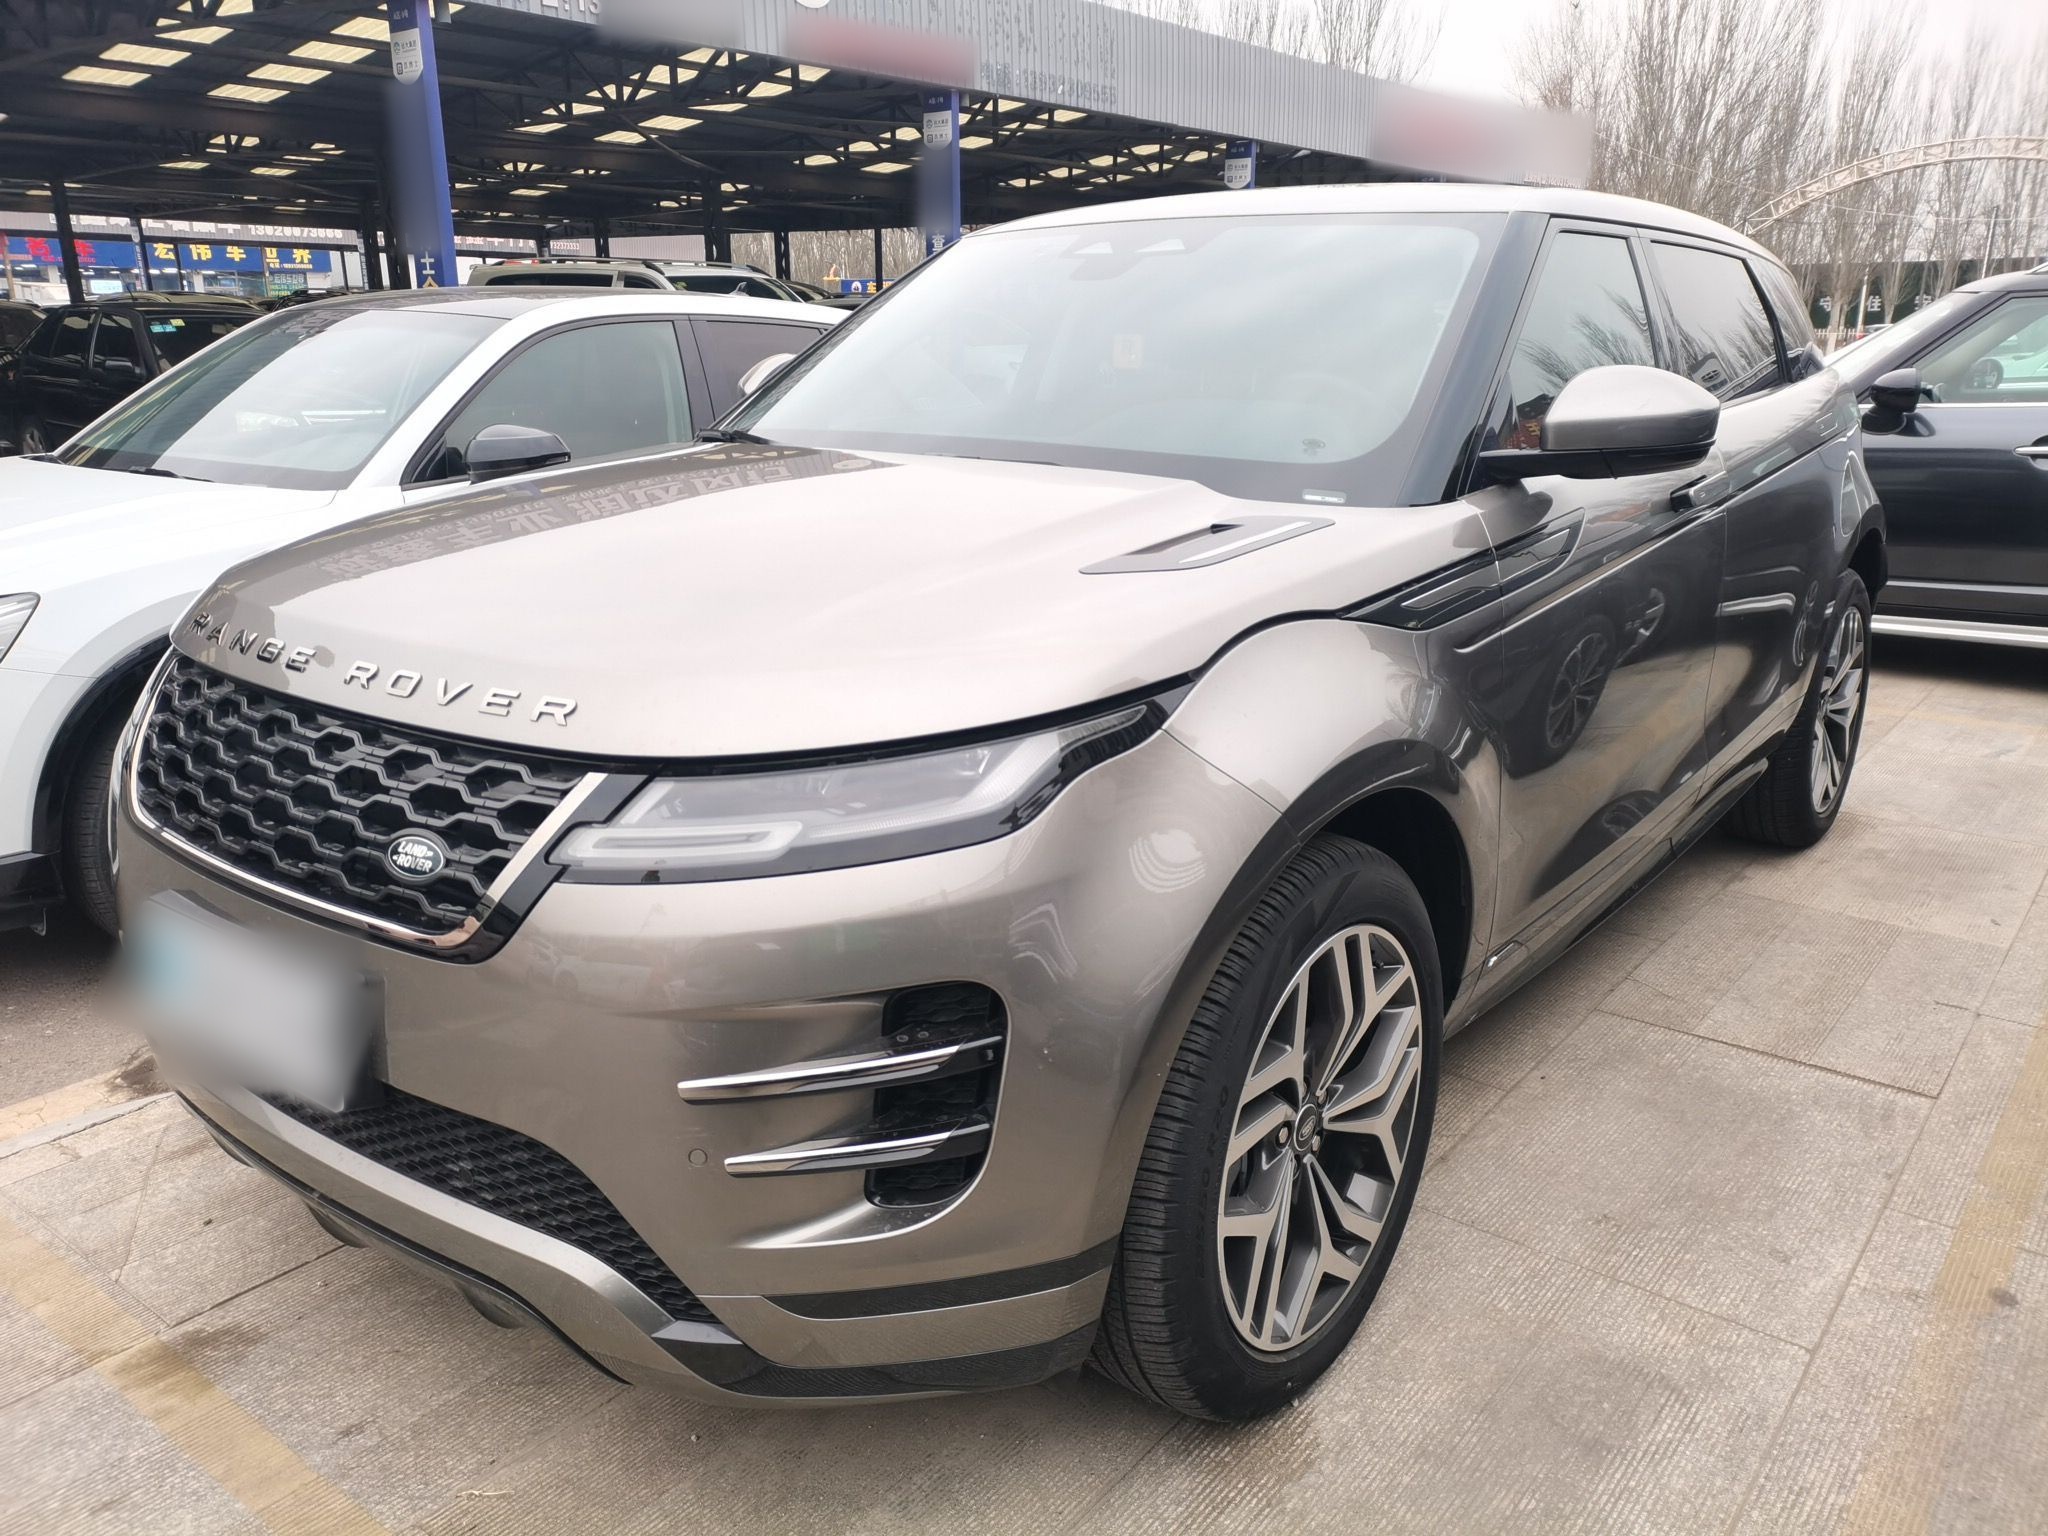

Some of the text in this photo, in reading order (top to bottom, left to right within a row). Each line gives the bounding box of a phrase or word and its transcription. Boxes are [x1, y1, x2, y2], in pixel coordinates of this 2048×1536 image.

[189, 612, 578, 727] RANGE ROVER
[398, 841, 428, 857] LAND
[396, 853, 433, 873] ROVER
